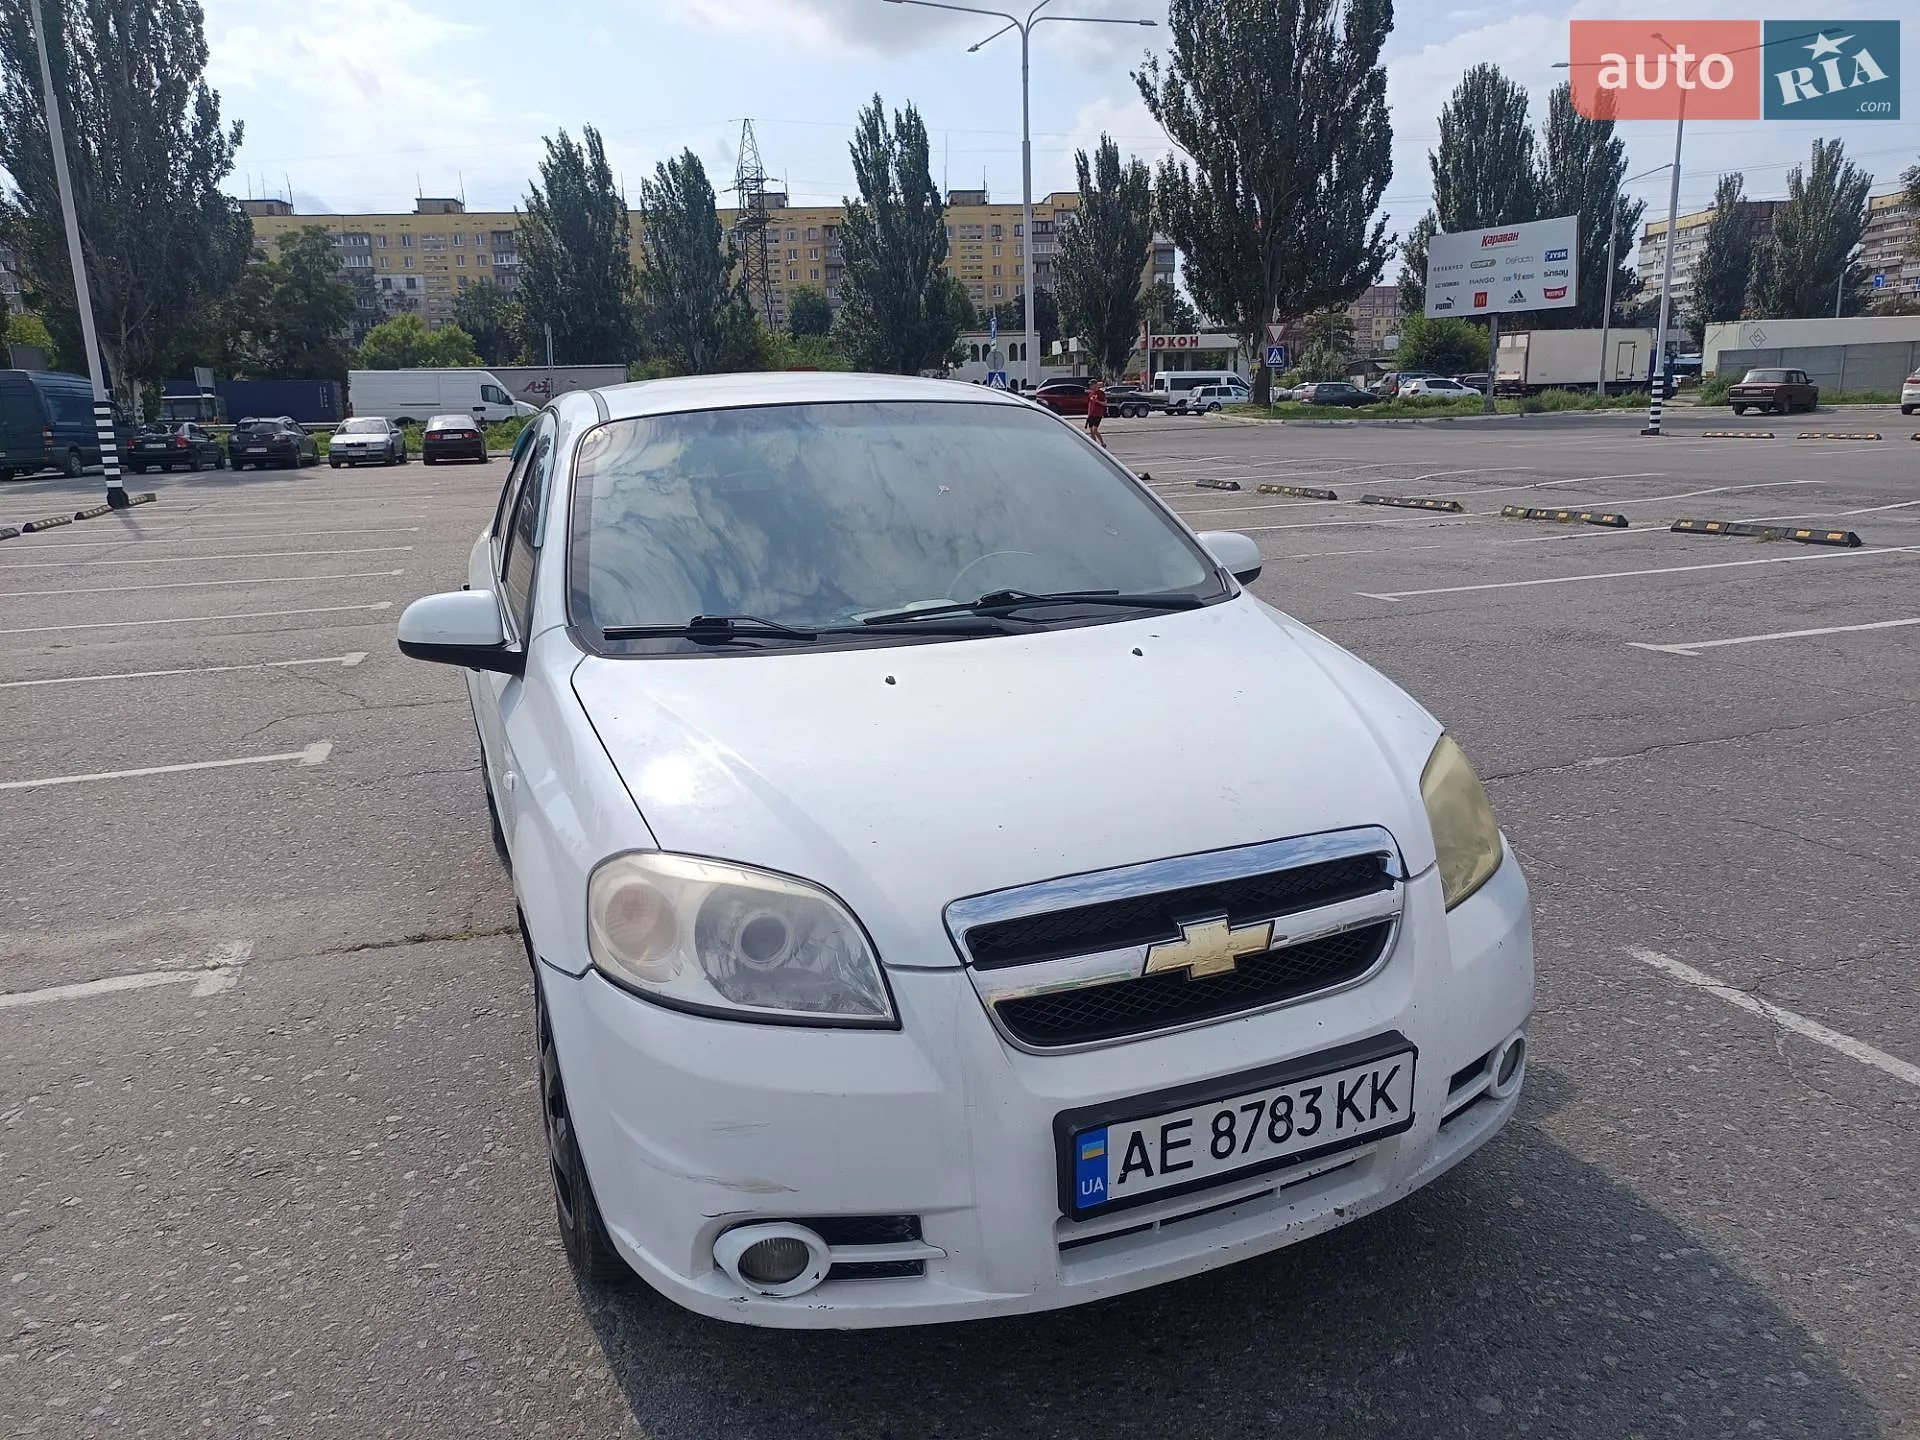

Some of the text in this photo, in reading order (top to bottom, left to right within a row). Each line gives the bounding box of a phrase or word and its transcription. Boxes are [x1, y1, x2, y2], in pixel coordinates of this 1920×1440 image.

[1481, 231, 1519, 247] Караван
[1549, 251, 1567, 259] JYSK
[1469, 277, 1495, 285] MANGO
[1435, 302, 1452, 310] PUMA
[1152, 336, 1199, 348] ЮКОН
[1117, 1064, 1401, 1185] AE 8783 KK
[1081, 1176, 1105, 1196] UA
